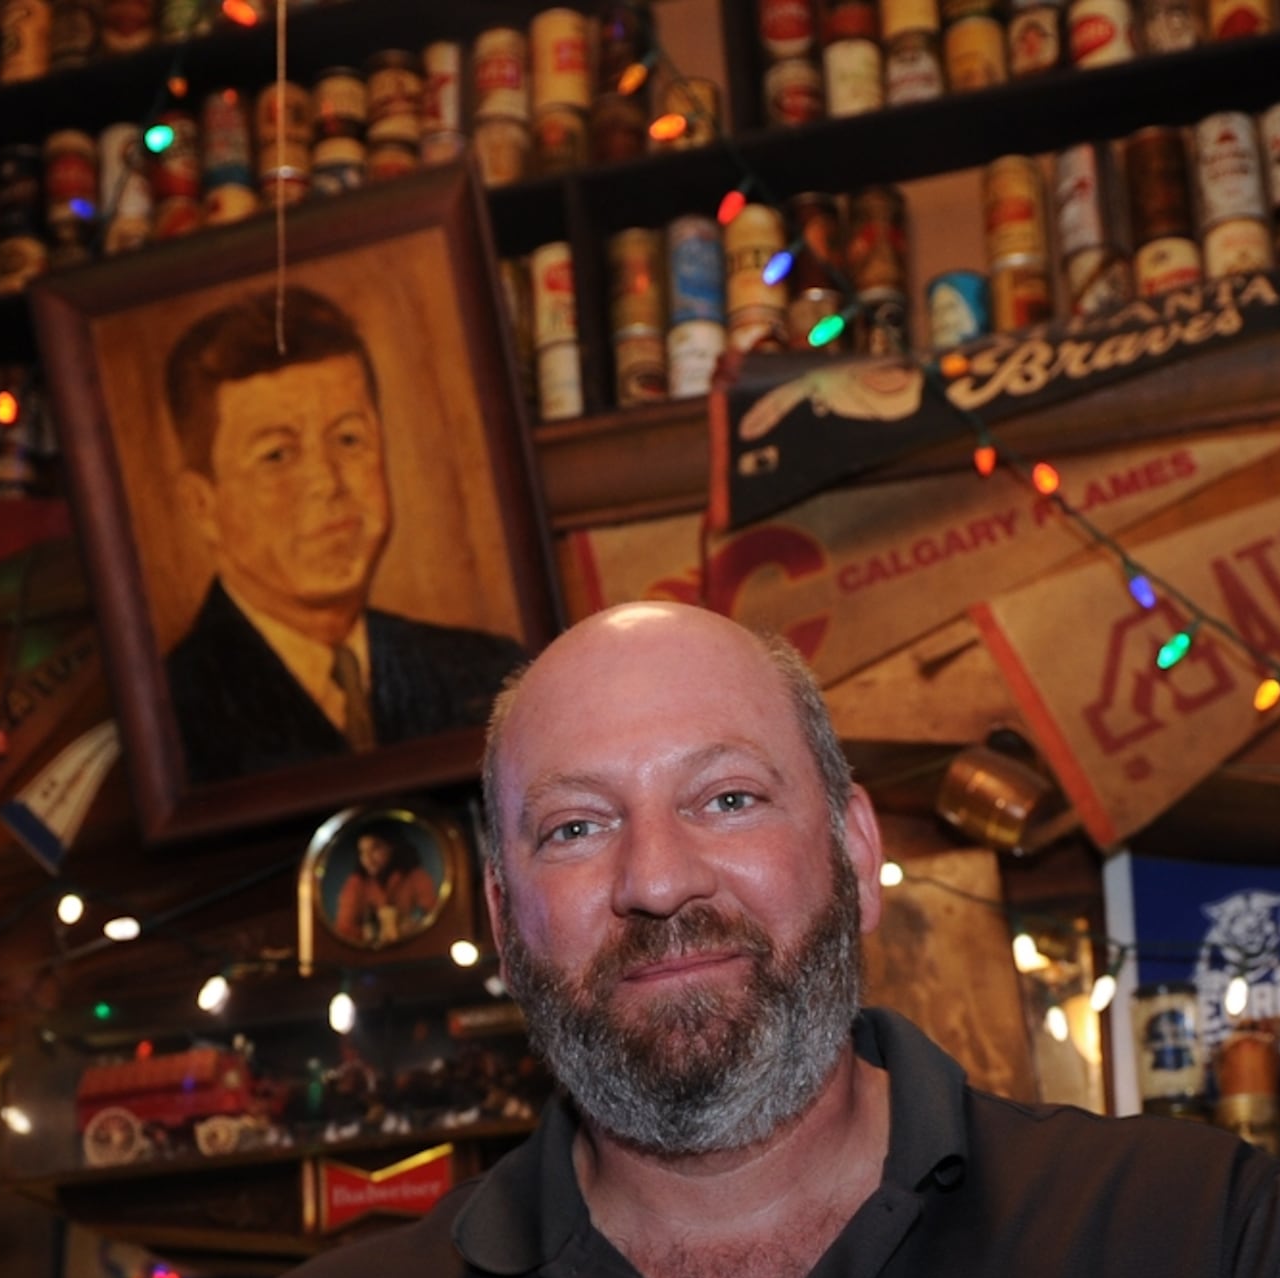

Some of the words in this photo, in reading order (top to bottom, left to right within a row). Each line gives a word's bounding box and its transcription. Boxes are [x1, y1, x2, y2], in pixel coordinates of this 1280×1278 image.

[945, 305, 1244, 411] Braves
[836, 508, 1019, 594] CALGARY
[1033, 450, 1198, 528] FAMES
